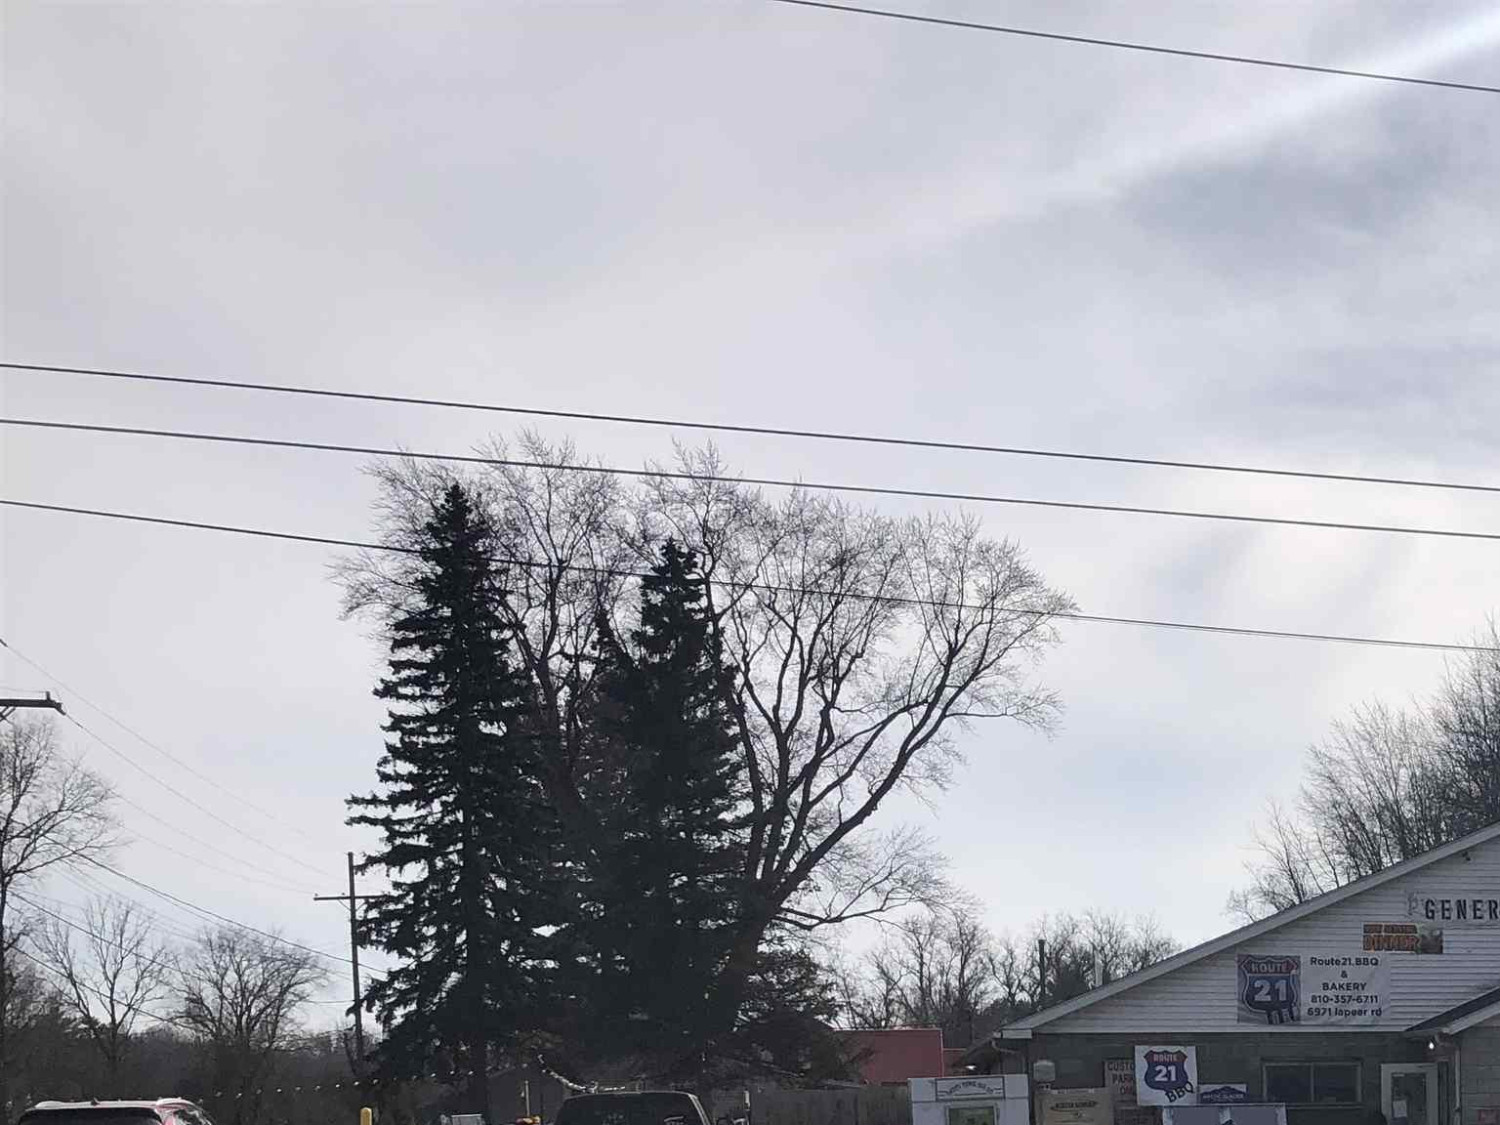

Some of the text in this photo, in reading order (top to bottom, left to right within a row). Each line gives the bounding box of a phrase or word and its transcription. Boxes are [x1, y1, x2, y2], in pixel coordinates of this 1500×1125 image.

[1251, 963, 1288, 973] ROUTE
[1341, 970, 1348, 979] &
[1253, 979, 1288, 1002] 21
[1322, 982, 1367, 991] BAKERY
[1310, 995, 1379, 1004] 810-357-6711
[1307, 1008, 1332, 1017] 6971
[1370, 1007, 1382, 1016] rd
[1153, 1053, 1178, 1062] ROUTE
[1154, 1065, 1178, 1082] 21
[1165, 1081, 1195, 1103] BBQ
